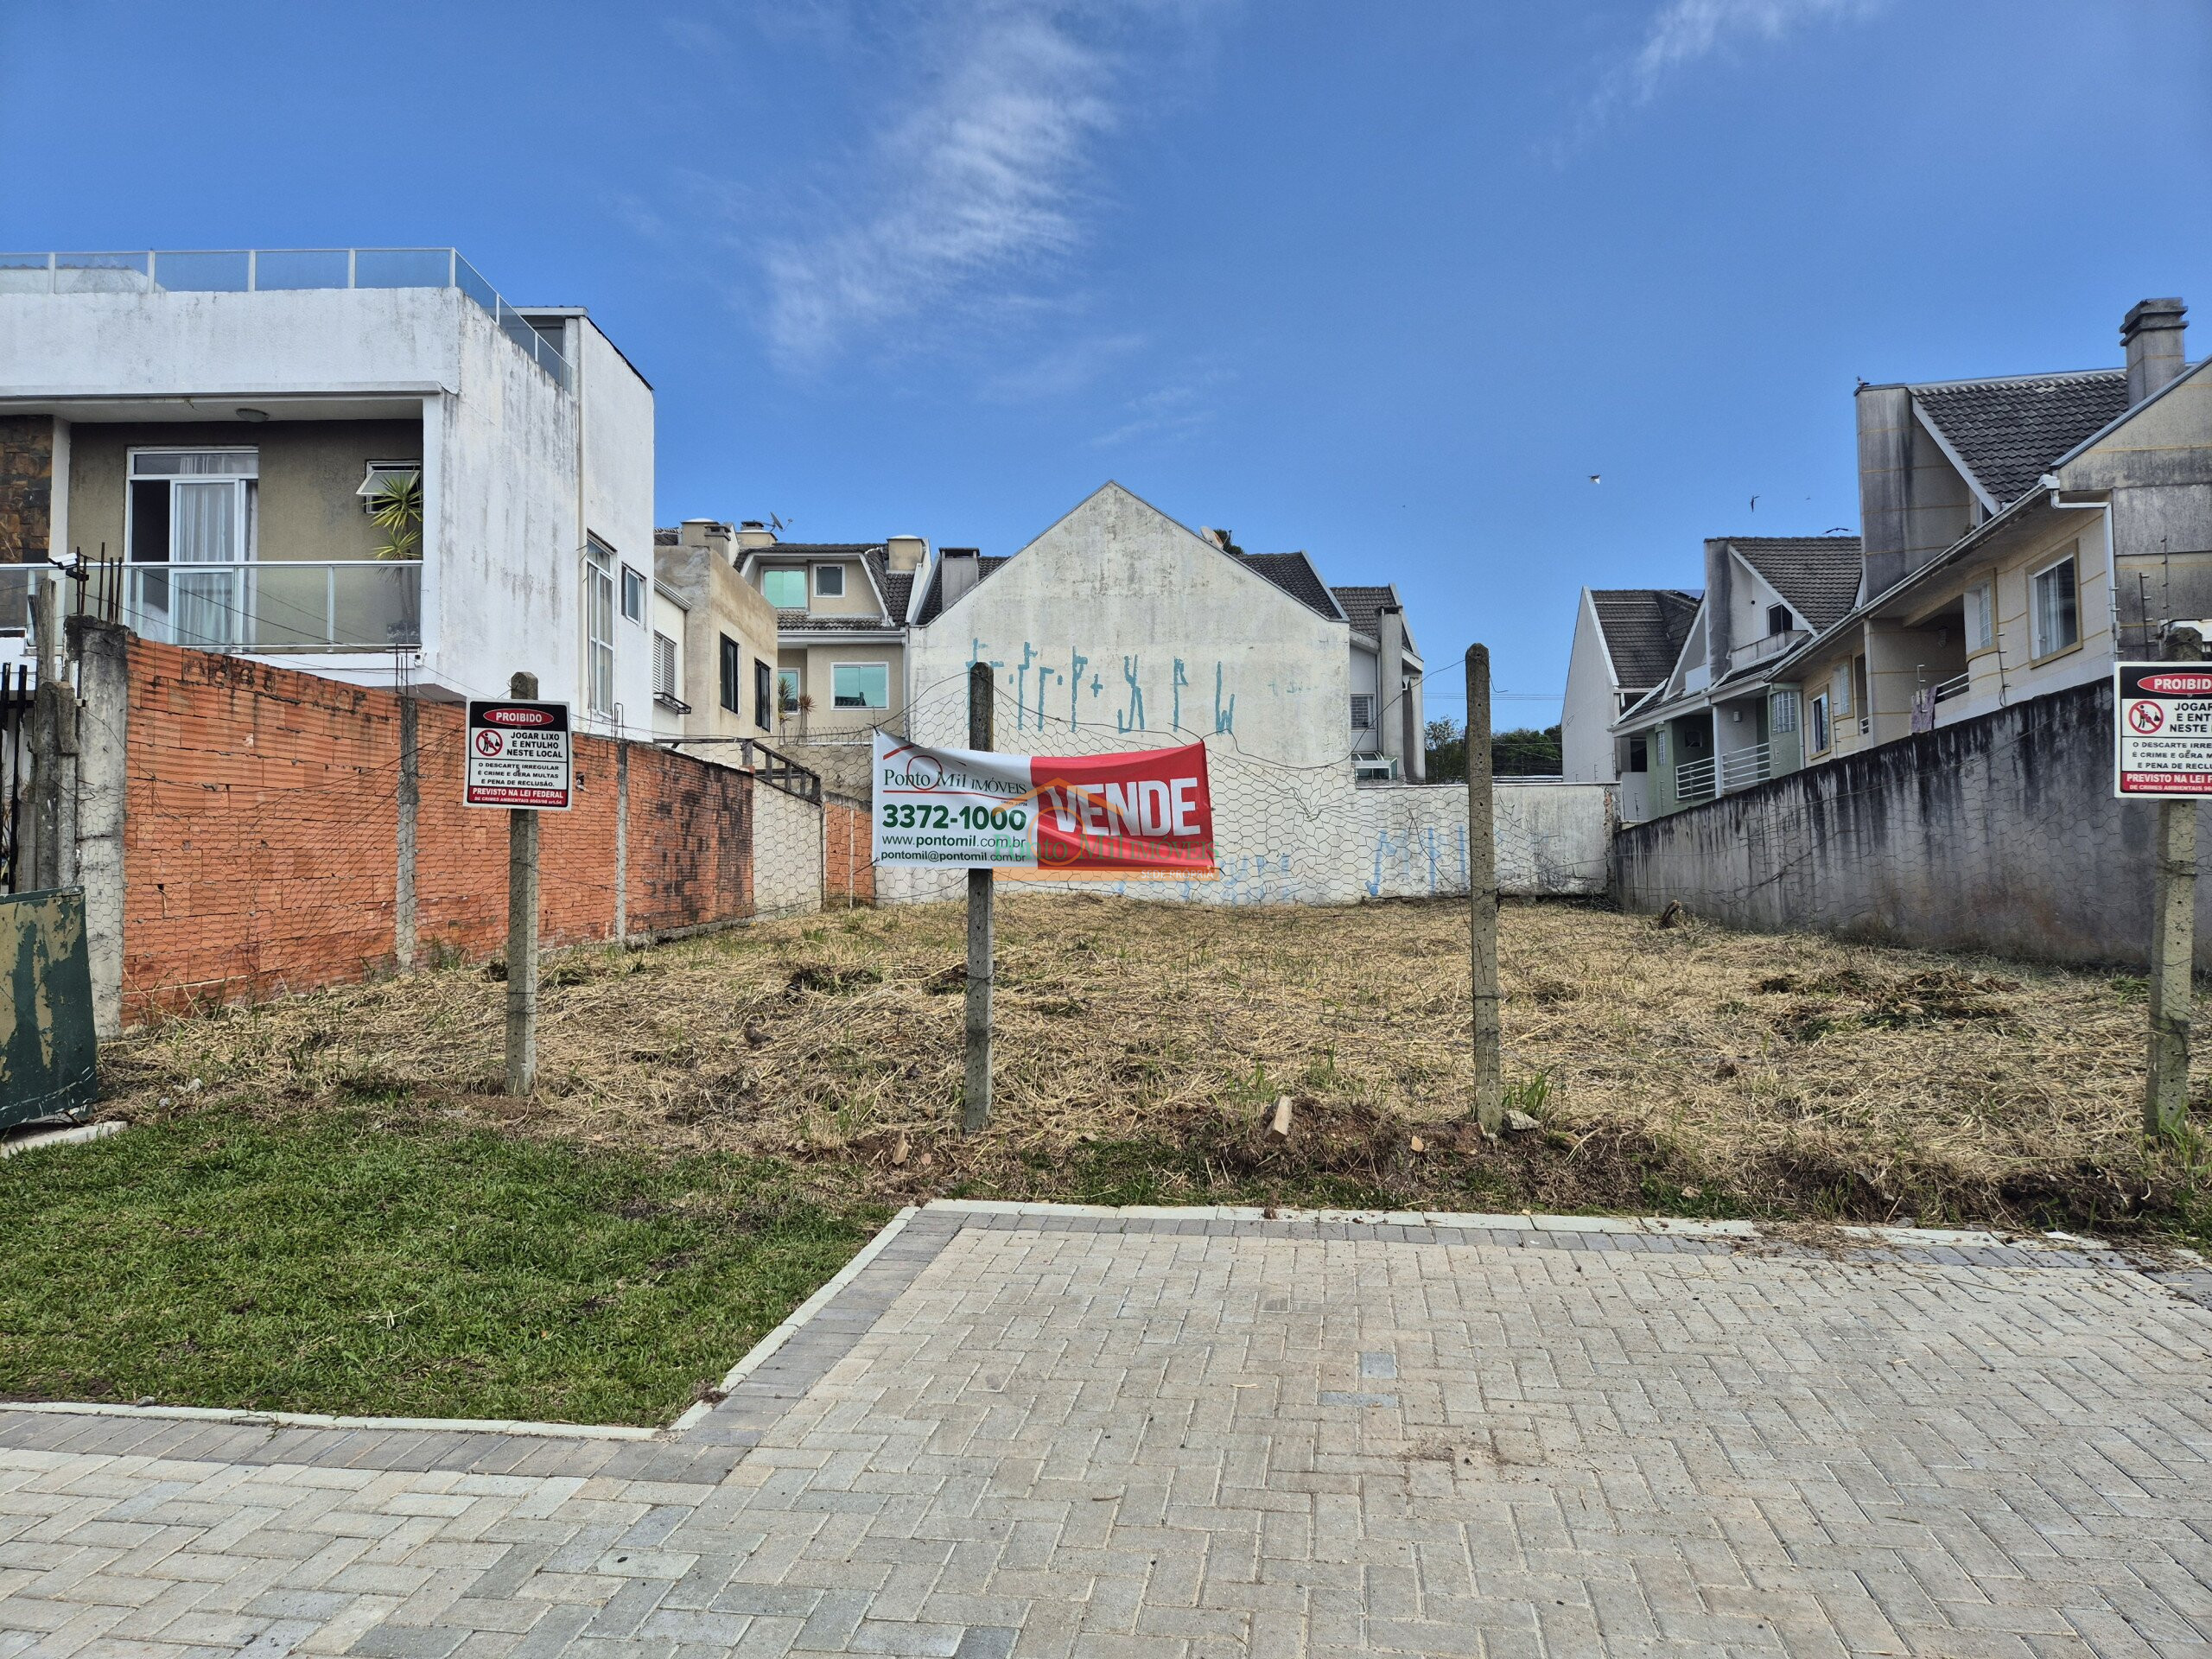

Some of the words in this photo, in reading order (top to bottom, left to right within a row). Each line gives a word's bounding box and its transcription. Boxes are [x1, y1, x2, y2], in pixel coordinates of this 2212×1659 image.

[2154, 678, 2212, 690] PROIBID
[496, 712, 542, 722] PROIBIDO
[2170, 724, 2208, 733] NESTE
[520, 741, 558, 749] ENTULHO
[884, 769, 931, 786] Ponto
[936, 771, 966, 788] Mil
[970, 778, 1027, 795] IMÓVEIS
[533, 790, 563, 798] FEDERAL
[1045, 778, 1201, 836] VENDE
[882, 804, 1027, 830] 3372-1000
[882, 835, 1026, 848] www.pontomil.com.br
[880, 850, 1026, 862] pontomil@pontomil.com.br
